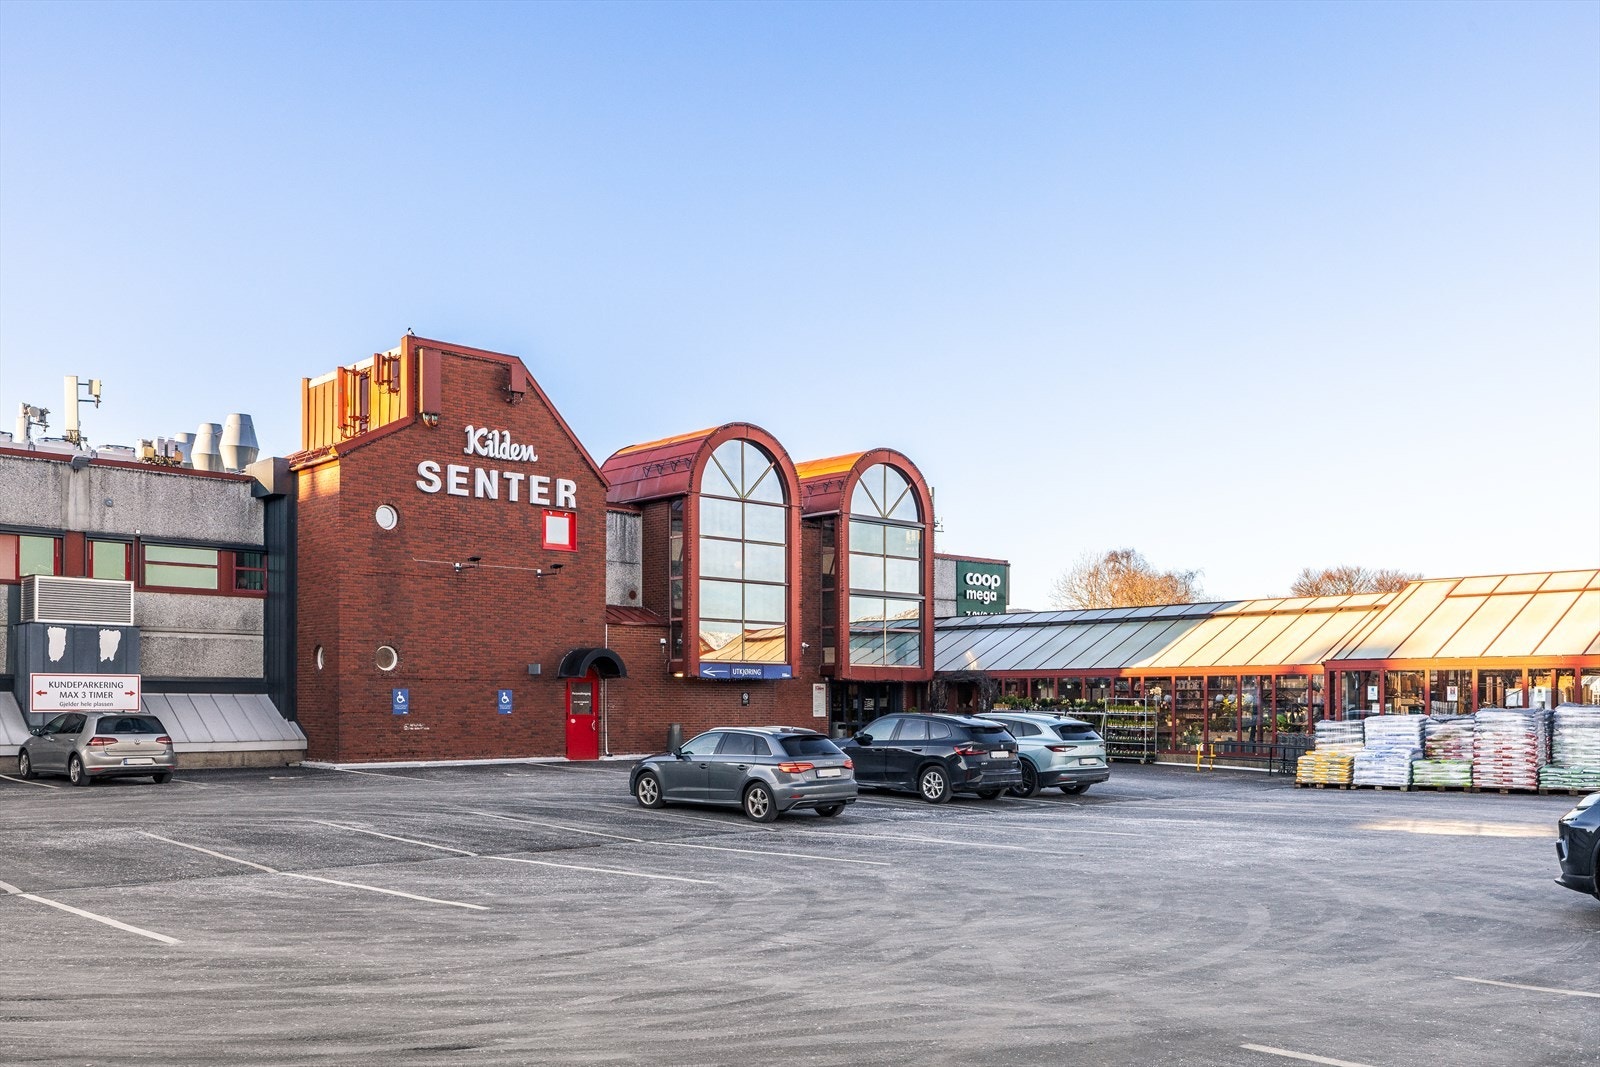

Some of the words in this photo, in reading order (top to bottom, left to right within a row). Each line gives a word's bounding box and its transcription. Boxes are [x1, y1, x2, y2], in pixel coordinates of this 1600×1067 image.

[463, 424, 538, 462] Kilden
[415, 460, 577, 509] SENTER
[965, 572, 1001, 589] coop
[966, 589, 997, 605] mega
[732, 668, 761, 677] UTKJØRING
[48, 681, 124, 689] KUNDEPARKERING
[59, 691, 79, 699] MAX
[81, 691, 87, 699] 3
[89, 691, 113, 699] TIMER
